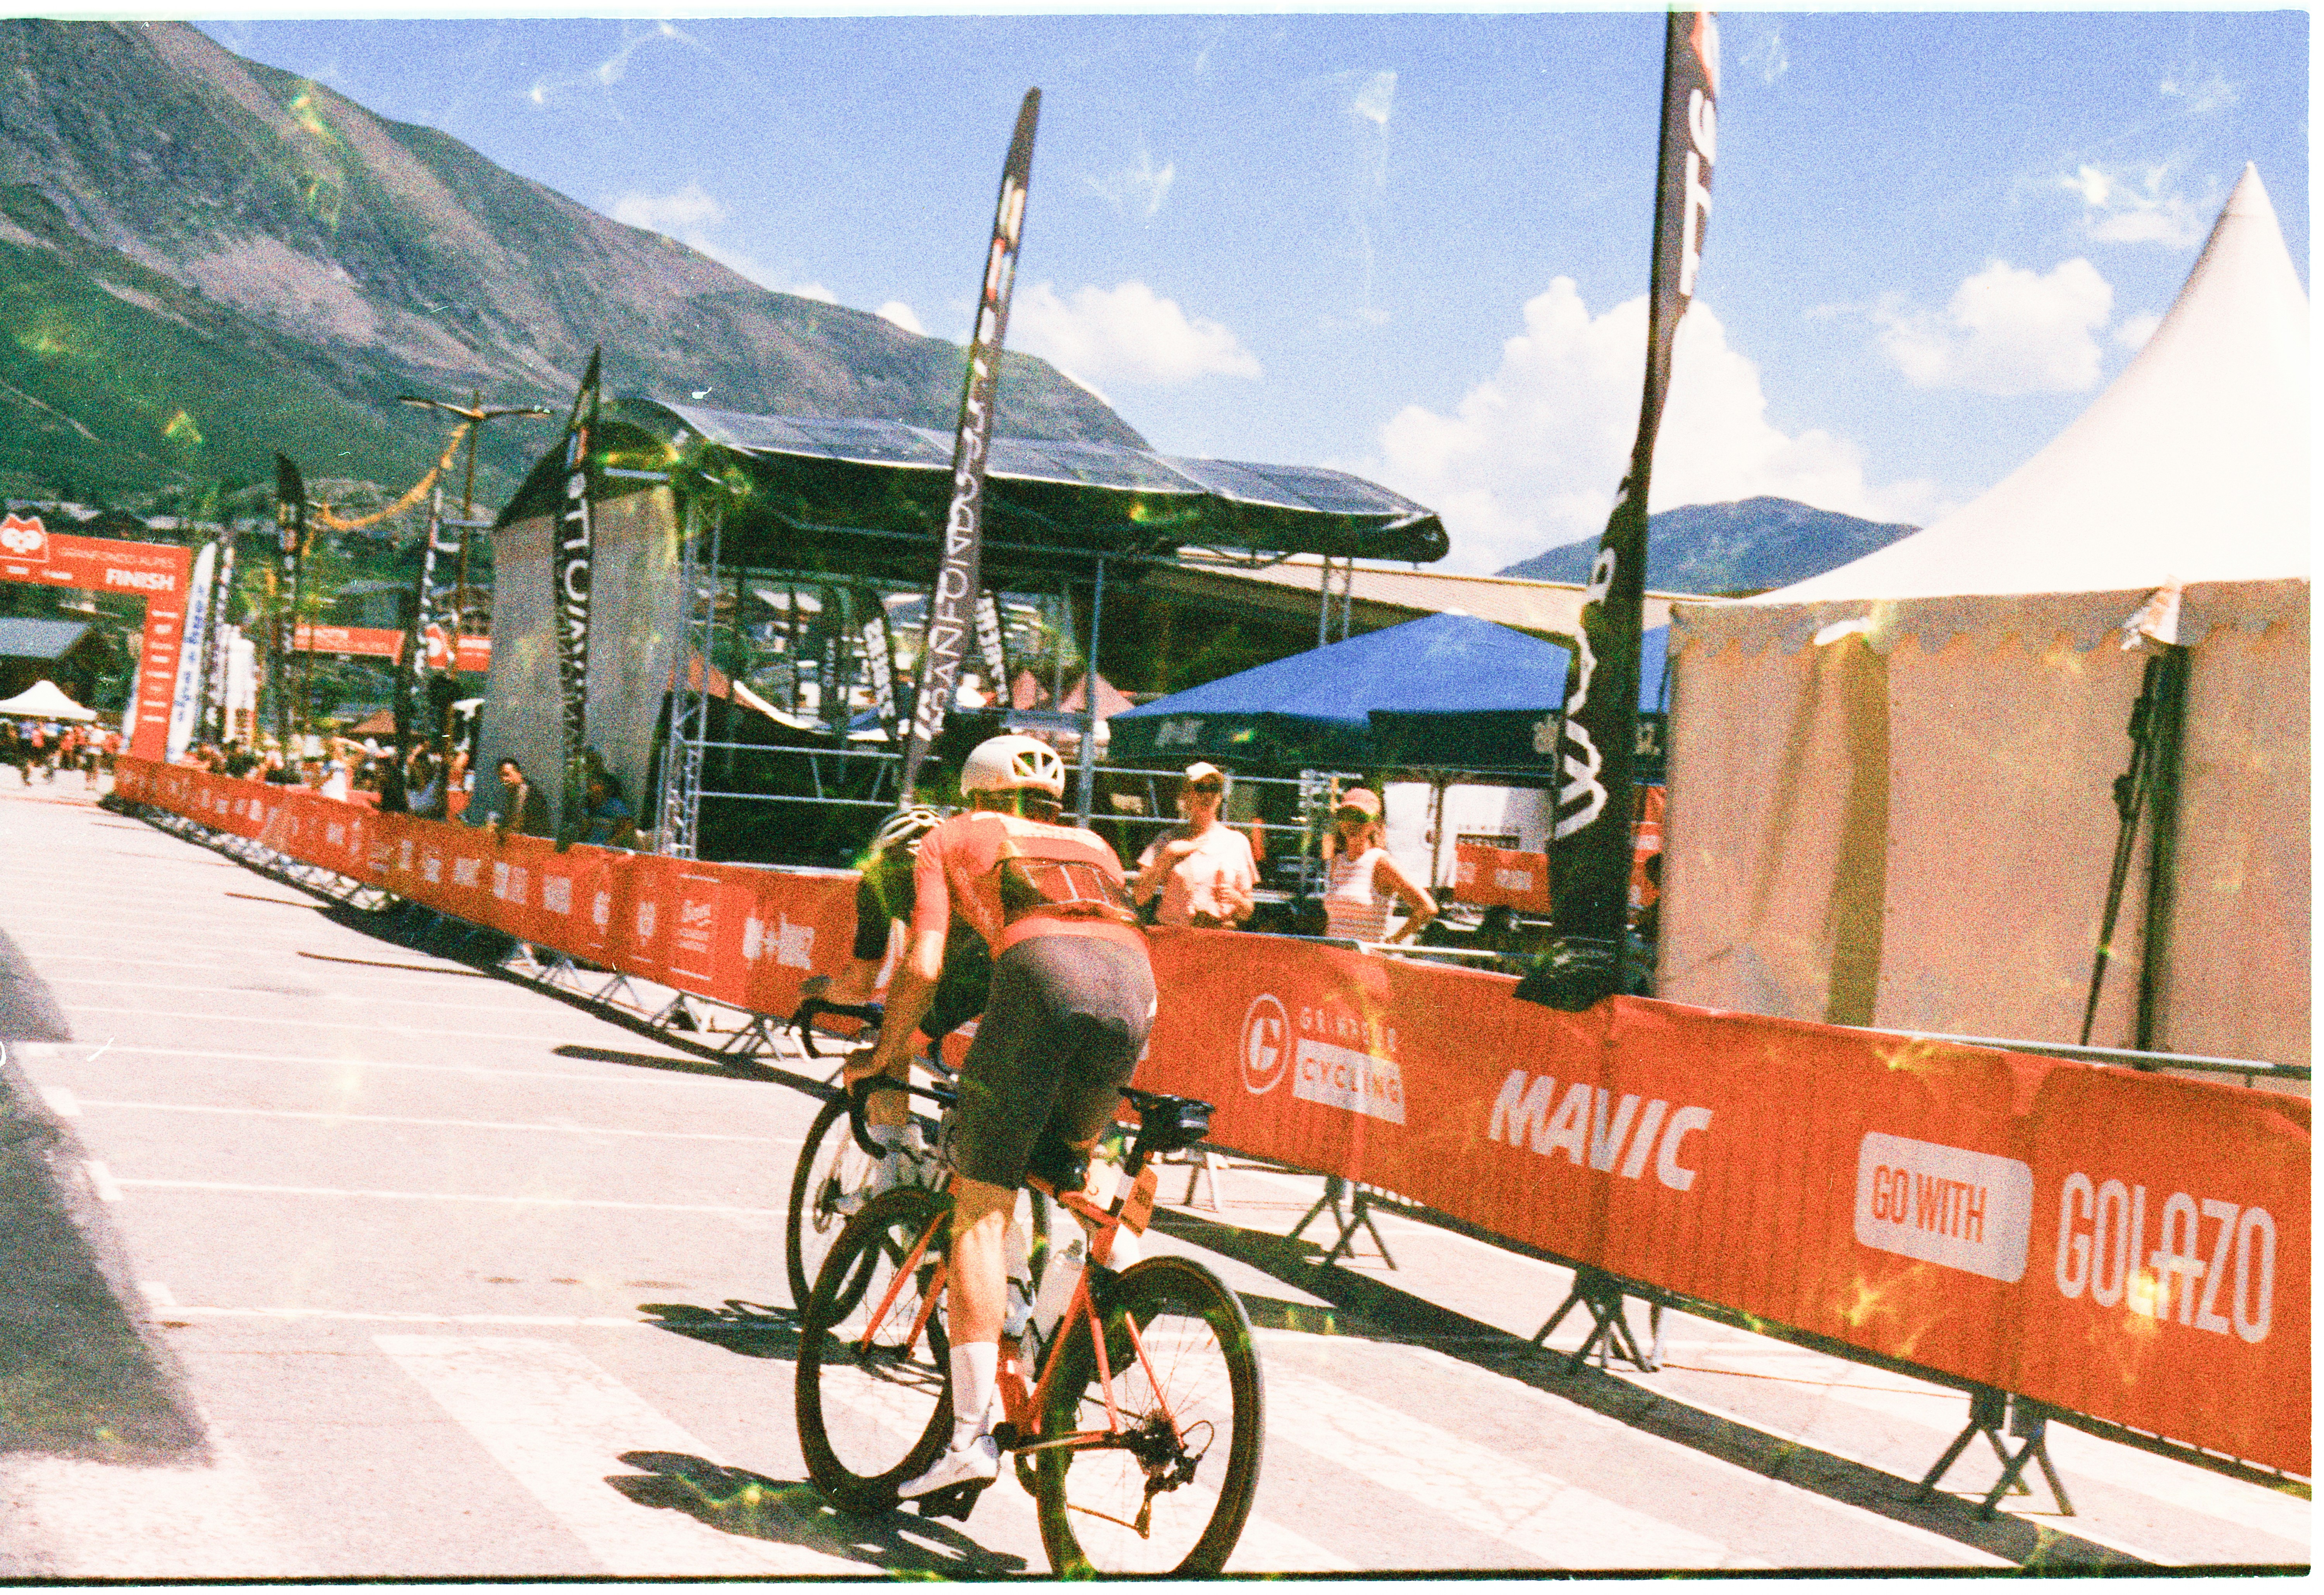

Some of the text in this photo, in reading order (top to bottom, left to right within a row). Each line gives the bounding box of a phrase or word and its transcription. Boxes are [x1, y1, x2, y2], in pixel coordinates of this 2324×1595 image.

[106, 568, 175, 591] FINISH
[1301, 1057, 1399, 1103] CYCLING
[1488, 1068, 1713, 1191] MAVIC
[1871, 1165, 1987, 1243] GO WITH
[2055, 1172, 2276, 1344] GOLAZO
